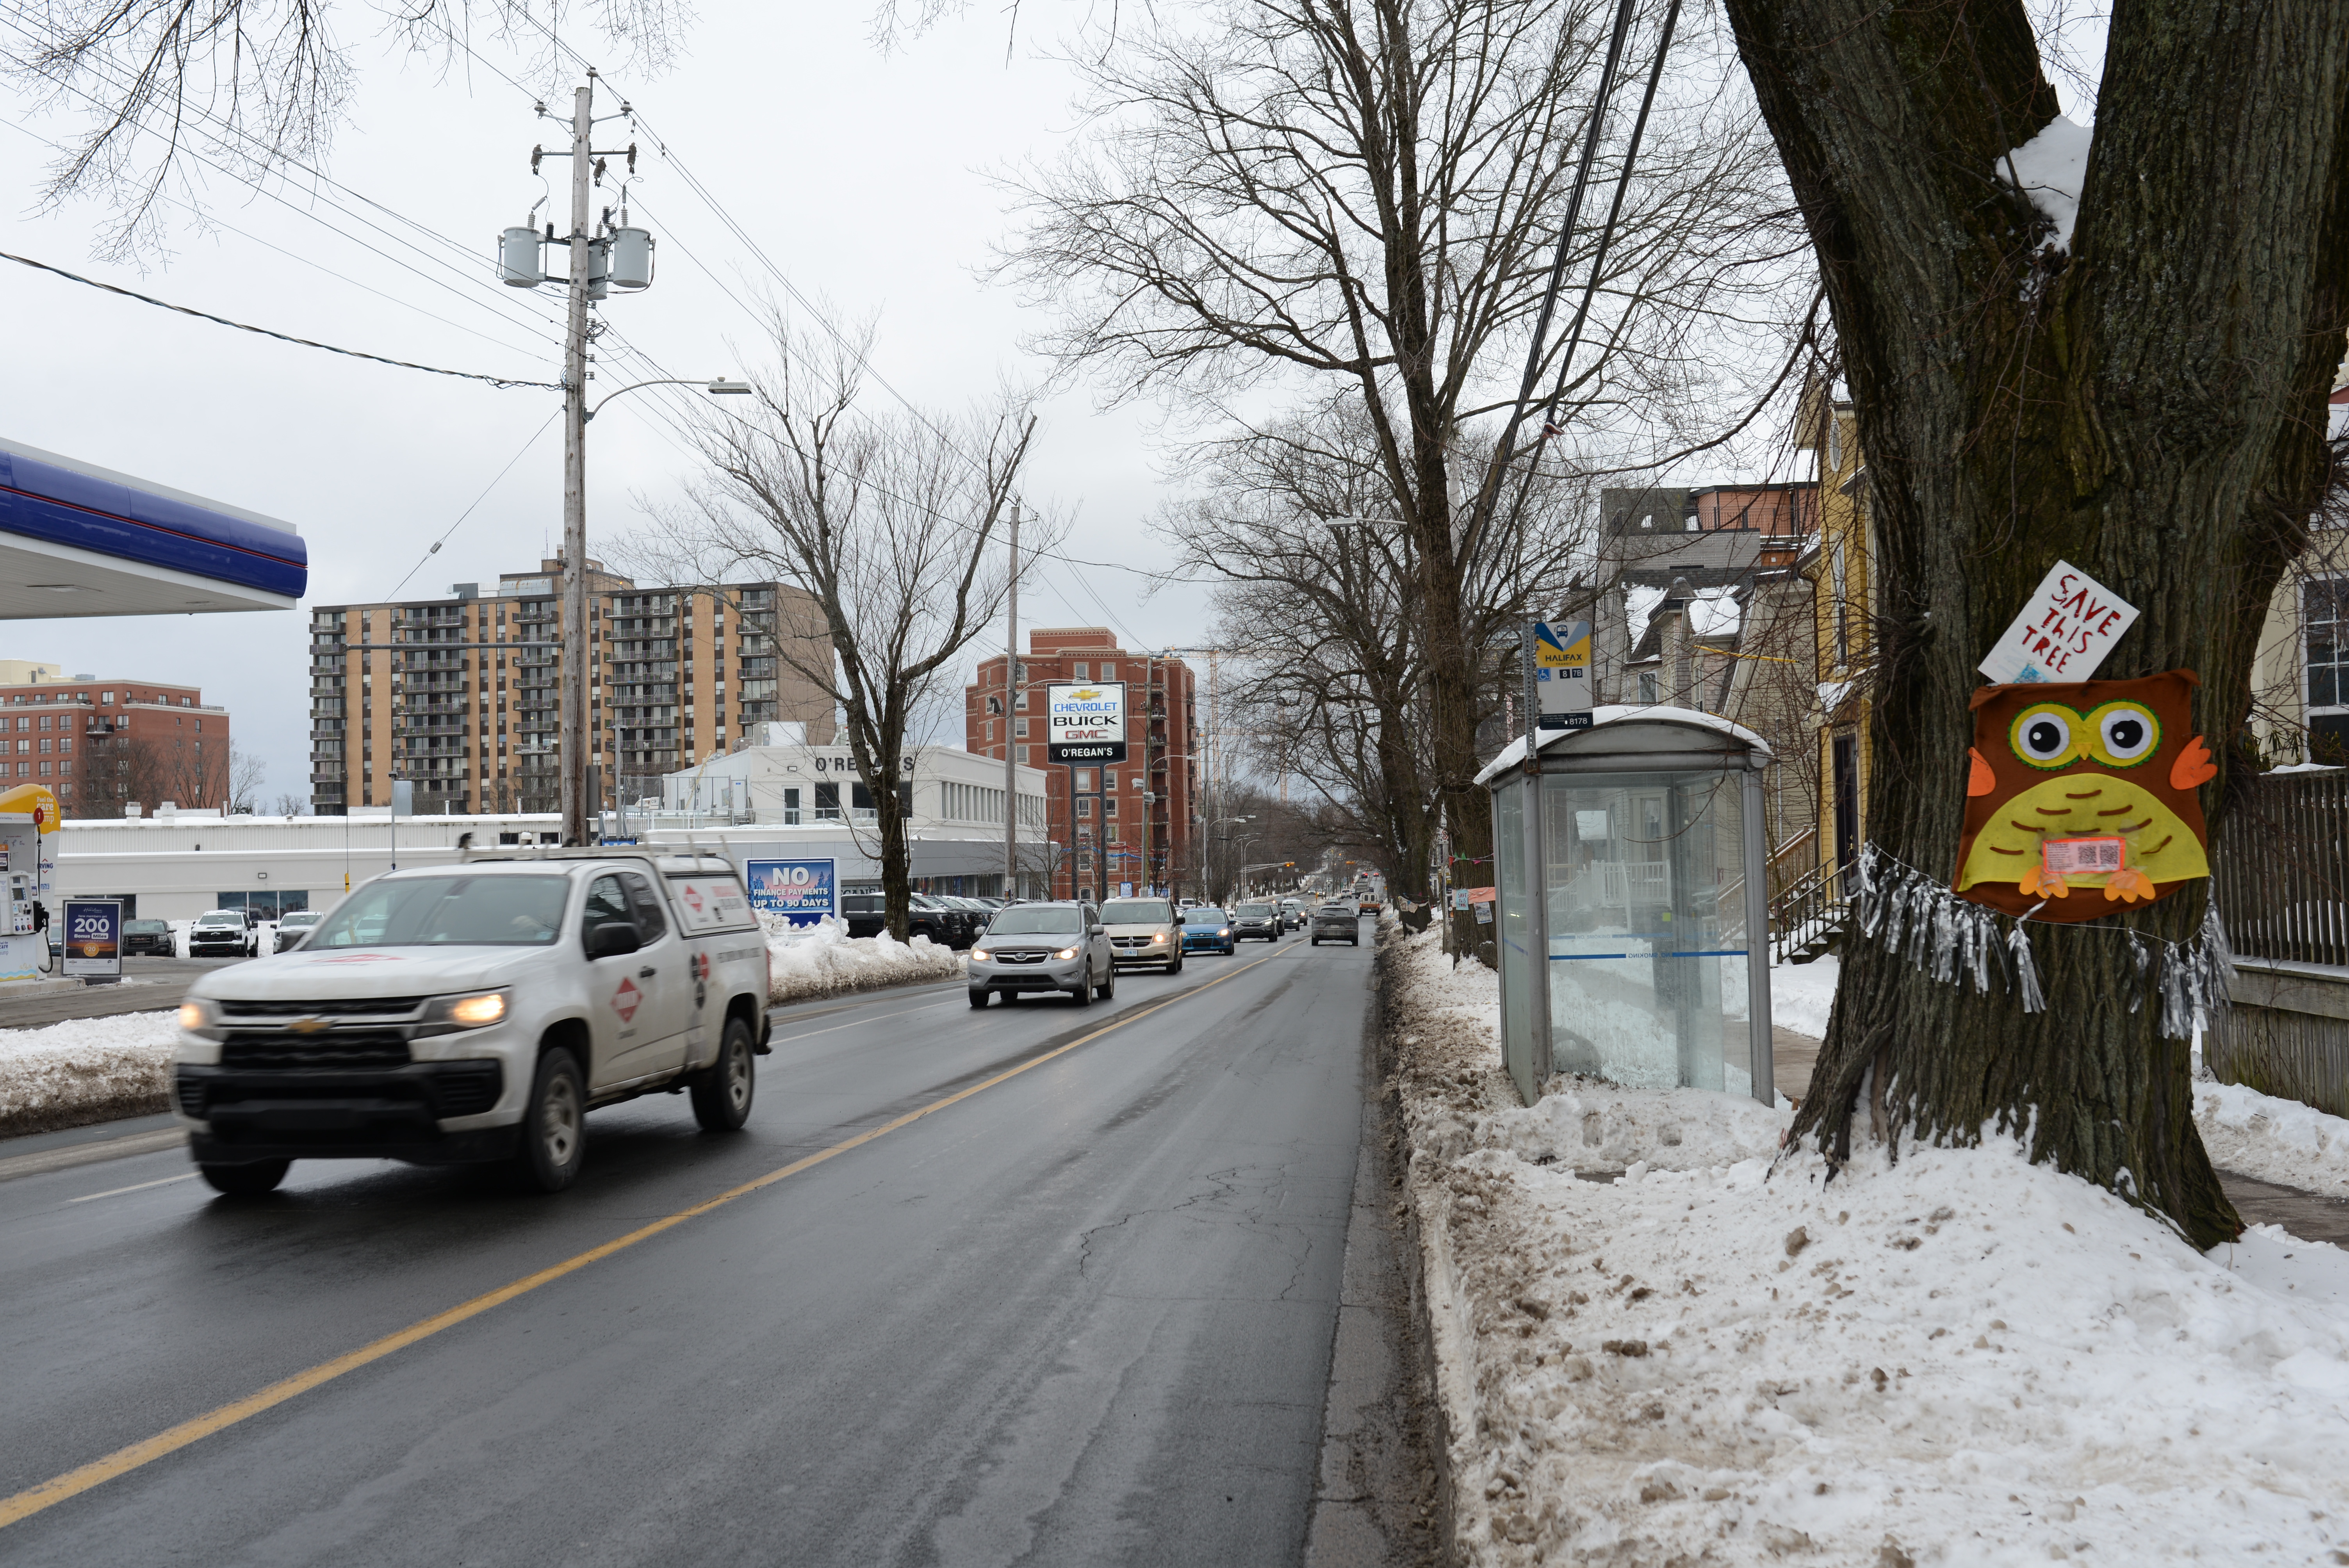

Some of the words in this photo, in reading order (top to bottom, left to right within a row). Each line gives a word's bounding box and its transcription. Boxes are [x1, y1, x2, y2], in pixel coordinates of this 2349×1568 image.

[2051, 574, 2121, 636] SAVE
[2022, 625, 2071, 674] TREE
[1054, 702, 1117, 712] CHEVROLET
[1053, 715, 1119, 726] BUICK
[1065, 729, 1108, 740] GMC
[1061, 747, 1113, 757] O'REGAN'S
[773, 867, 809, 886] NO
[754, 900, 768, 908] UP
[75, 918, 109, 932] 200
